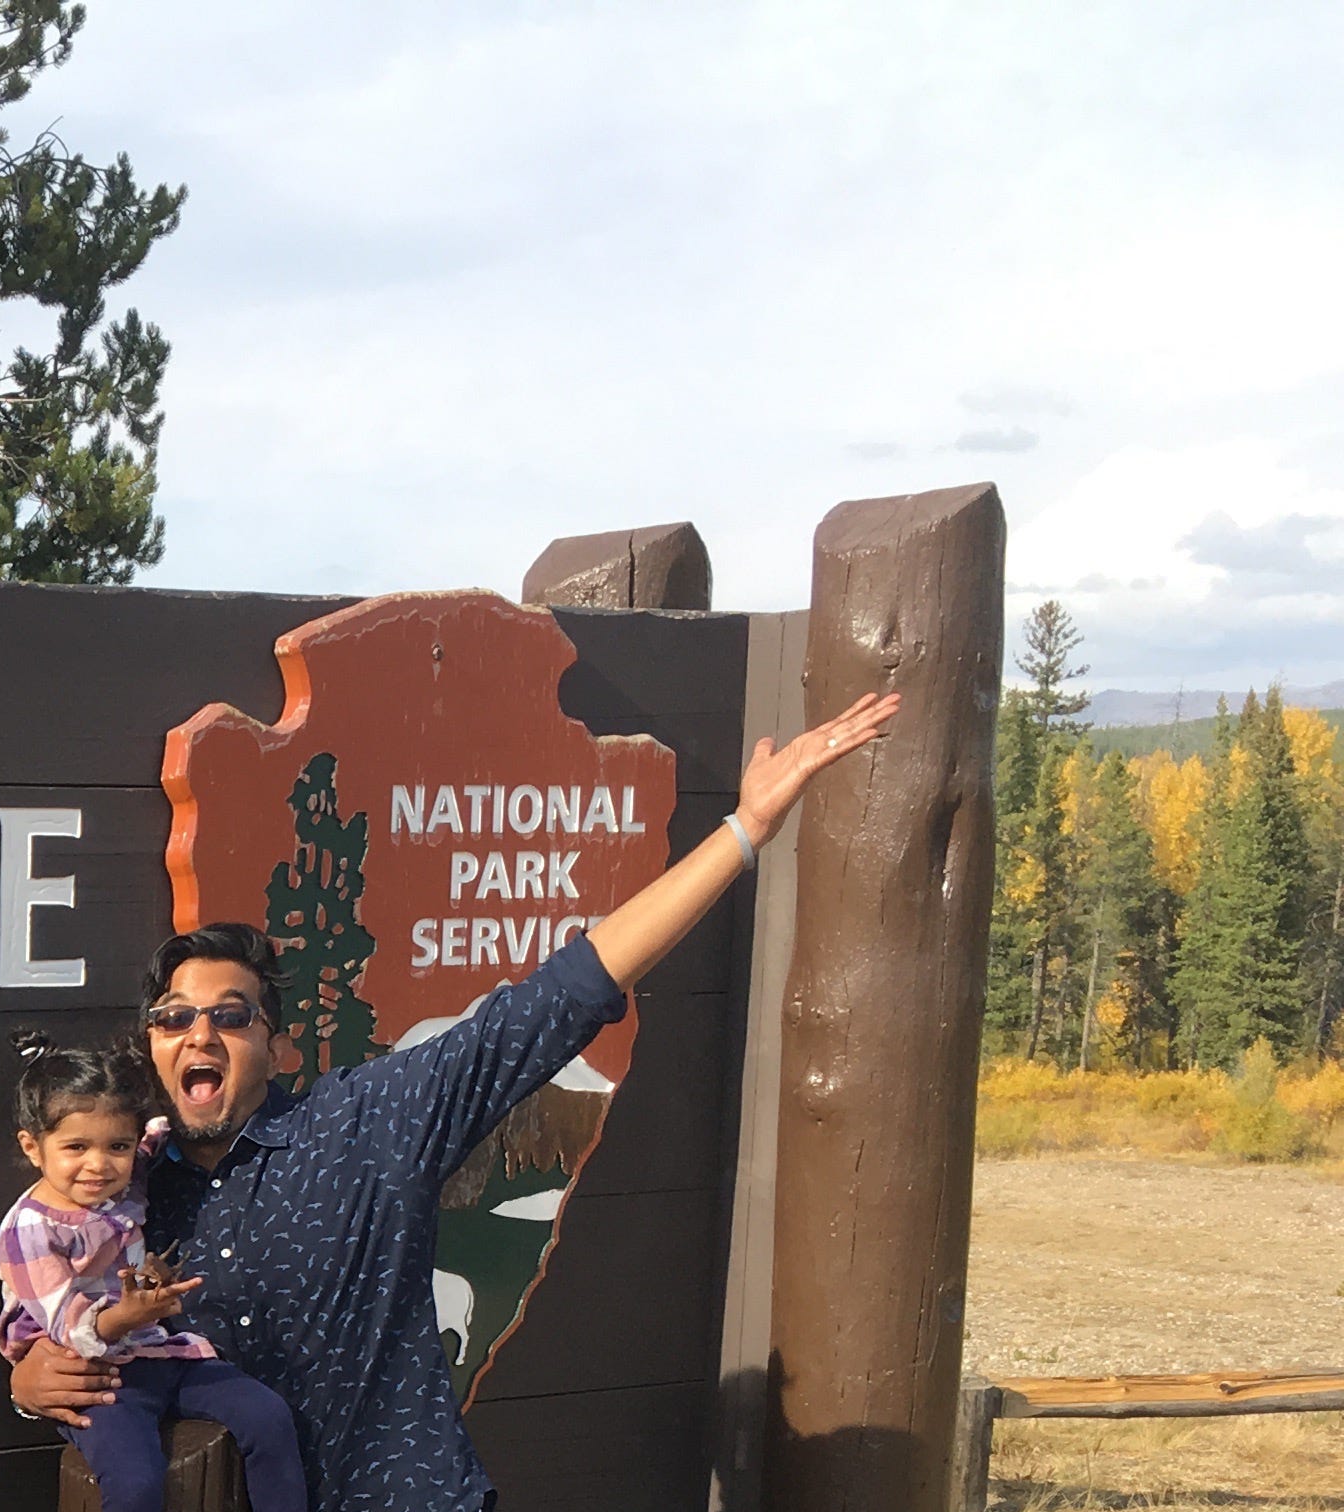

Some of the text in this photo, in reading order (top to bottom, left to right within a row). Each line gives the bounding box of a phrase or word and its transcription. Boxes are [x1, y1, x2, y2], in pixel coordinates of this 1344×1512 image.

[390, 784, 646, 834] NATIONAL
[449, 850, 581, 900] PARK
[411, 915, 606, 967] SERVIC
